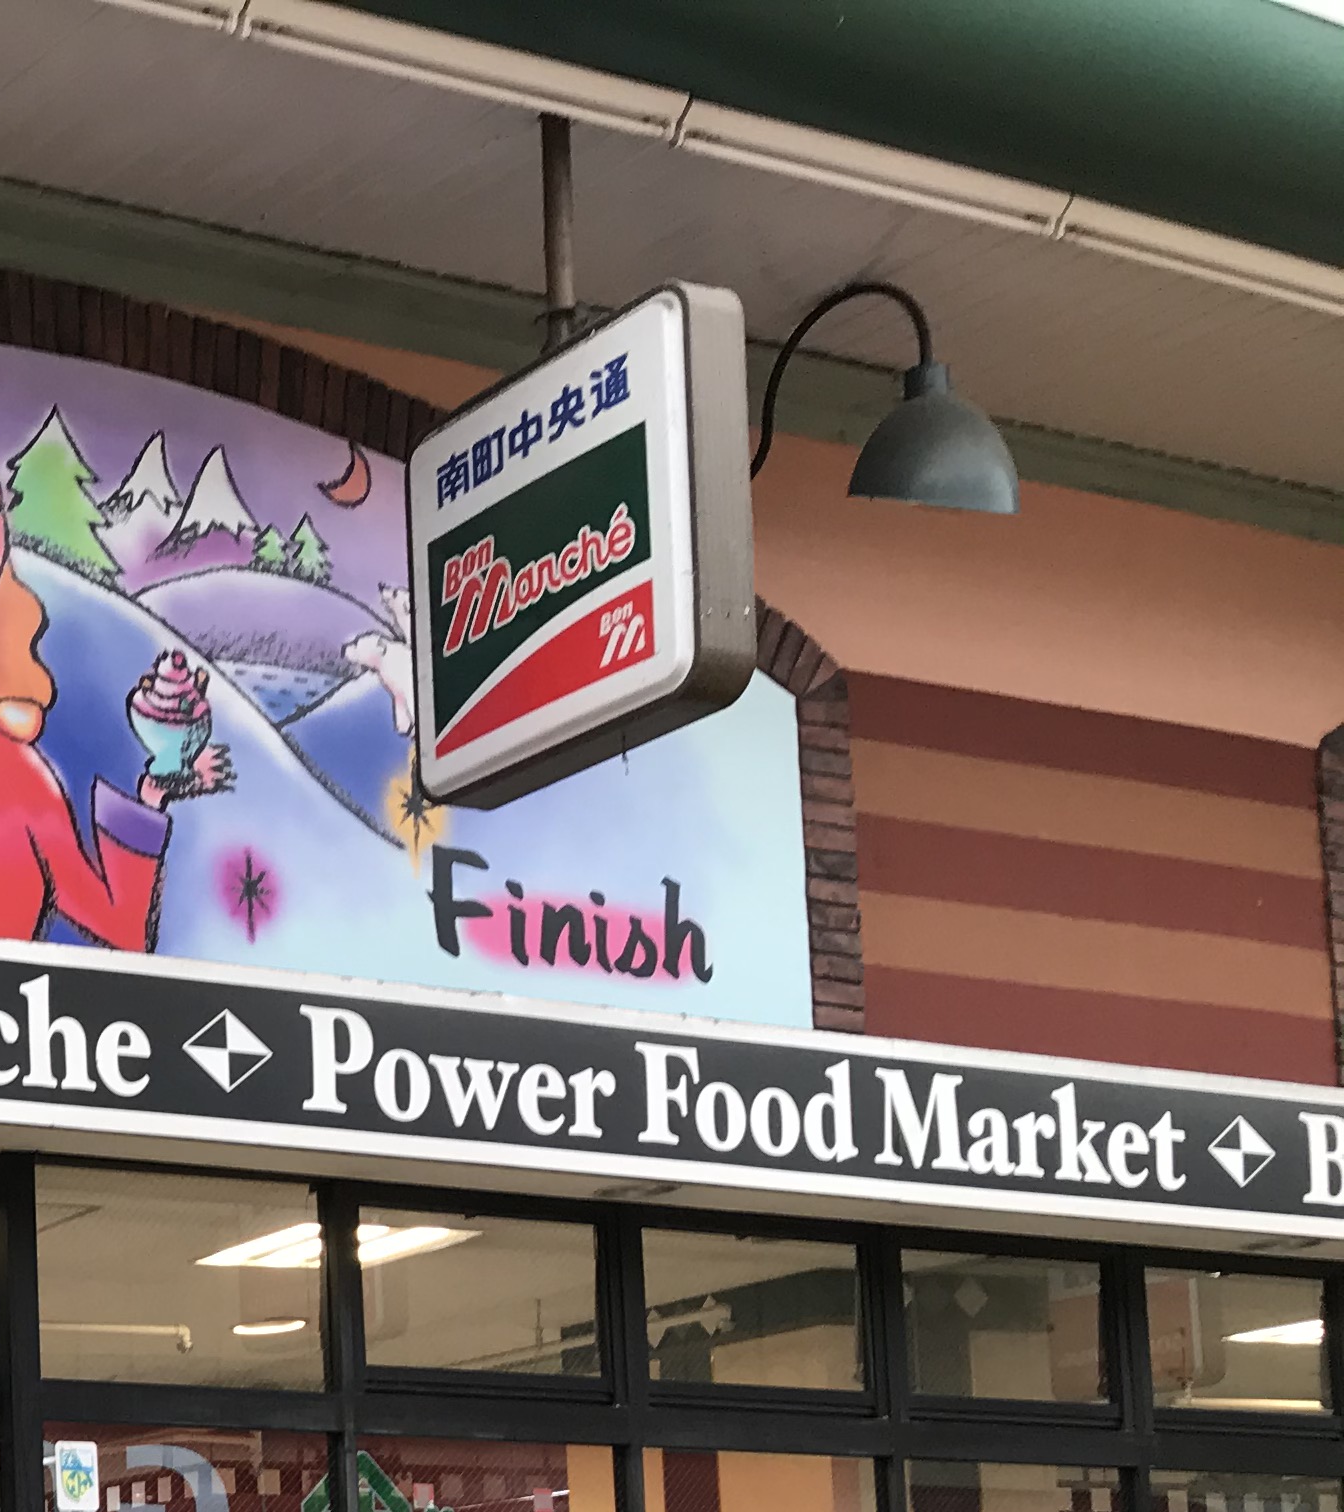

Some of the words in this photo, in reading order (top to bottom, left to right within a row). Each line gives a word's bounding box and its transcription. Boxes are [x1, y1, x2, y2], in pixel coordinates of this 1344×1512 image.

[437, 351, 630, 510] 南町中央通
[442, 534, 494, 602] Bon
[443, 502, 636, 657] Marché
[599, 600, 633, 638] Bon
[428, 843, 713, 984] Finish
[299, 1004, 615, 1140] Power
[634, 1041, 859, 1162] Food
[874, 1067, 1187, 1192] Market
